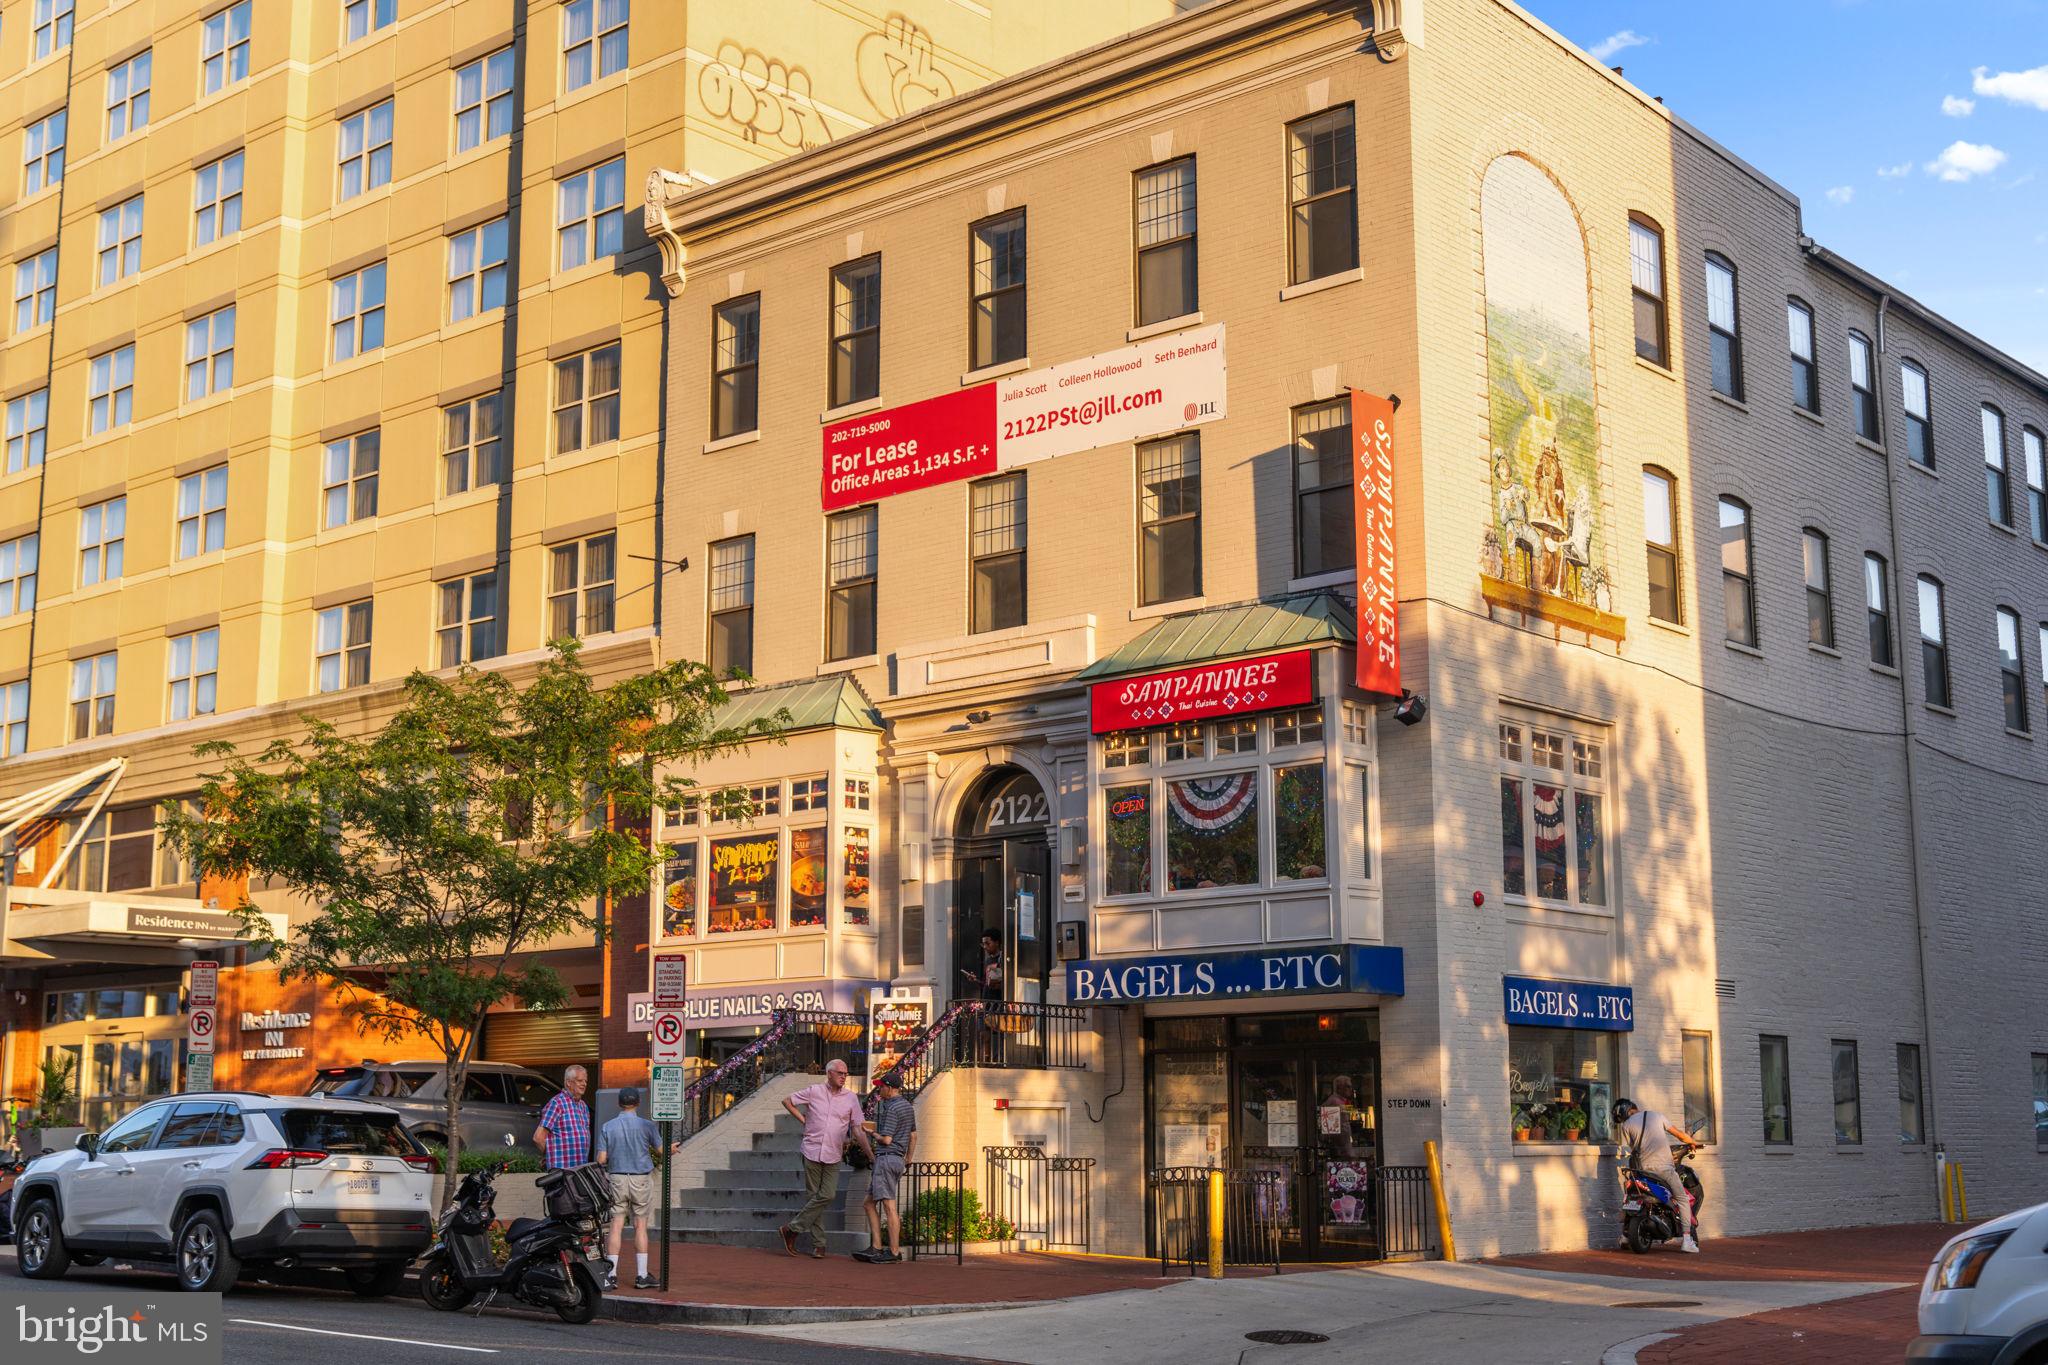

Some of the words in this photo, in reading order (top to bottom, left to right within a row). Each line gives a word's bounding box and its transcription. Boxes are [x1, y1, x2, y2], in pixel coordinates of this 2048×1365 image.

[1154, 350, 1176, 364] Seth
[1177, 339, 1217, 359] Benhard
[1058, 371, 1092, 388] Colleen
[1093, 358, 1142, 379] Hollowood
[1003, 387, 1023, 403] Julia
[1025, 383, 1047, 397] Scott
[1004, 388, 1163, 440] 2122PSt@jll.com
[1198, 401, 1217, 416] JLL
[831, 419, 891, 443] 202-719-5000
[831, 453, 862, 475] For
[865, 439, 918, 467] Lease
[831, 473, 870, 494] Office
[872, 464, 910, 484] Areas
[912, 452, 950, 476] 1,134
[953, 445, 977, 465] S.F.
[1374, 418, 1396, 669] SAMPANNEE
[1120, 661, 1279, 705] SAMPANNEE
[1178, 701, 1193, 711] Thai
[1195, 699, 1218, 709] Cuisine
[989, 792, 1048, 827] 2122
[1112, 797, 1145, 816] OPEN
[135, 914, 194, 930] Residence
[195, 921, 209, 930] INN
[1073, 962, 1216, 1001] BAGELS
[1261, 954, 1342, 991] ETC
[723, 995, 772, 1017] NAILS
[775, 992, 788, 1010] &
[791, 990, 825, 1011] SPA
[1509, 988, 1579, 1018] BAGELS
[1597, 995, 1632, 1021] ETC
[241, 1010, 311, 1031] Residence
[264, 1031, 284, 1047] INN
[243, 1049, 256, 1060] BY
[257, 1048, 305, 1060] MARRIOTT
[1509, 1070, 1550, 1101] Bagels
[1388, 1099, 1408, 1108] STEP
[1410, 1099, 1431, 1108] DOWN
